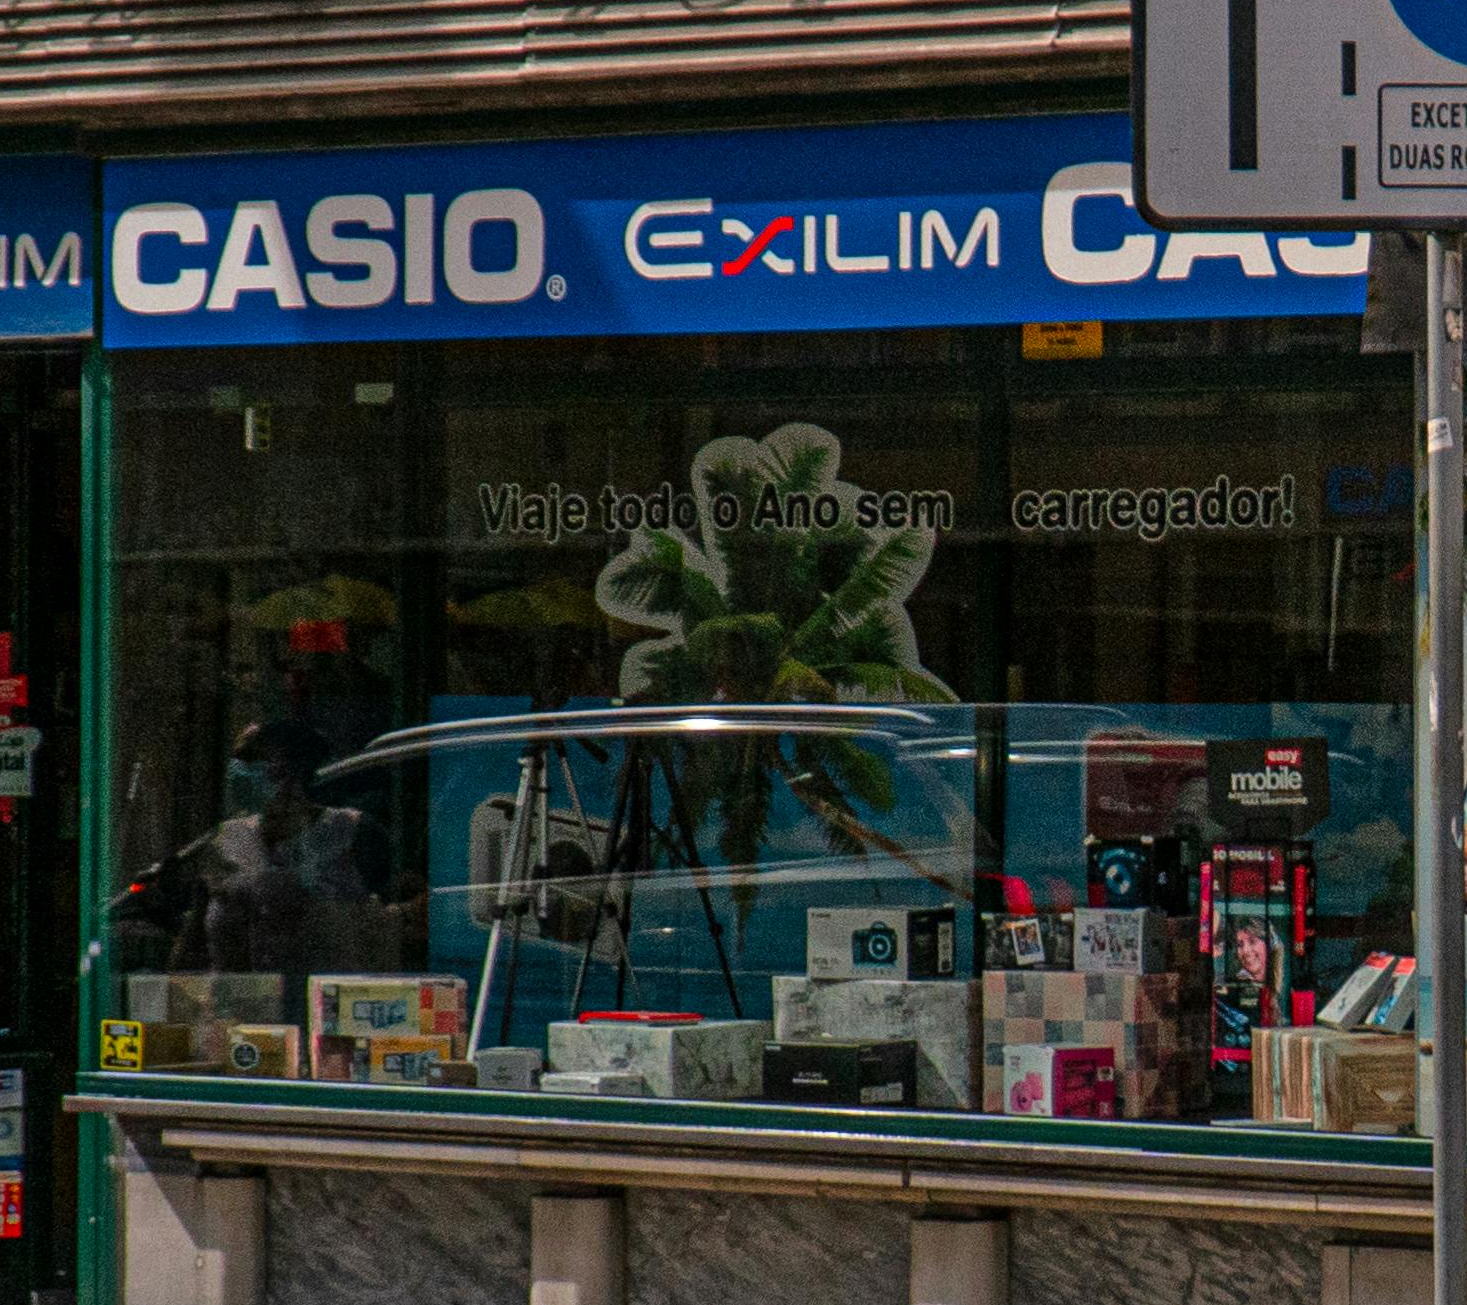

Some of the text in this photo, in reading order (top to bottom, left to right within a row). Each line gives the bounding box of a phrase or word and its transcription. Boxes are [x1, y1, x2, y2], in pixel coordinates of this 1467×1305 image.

[1390, 143, 1445, 170] DUAS
[111, 188, 546, 315] CASIO
[623, 197, 1001, 279] EXILIM
[479, 484, 586, 545] Viaje
[602, 484, 698, 531] todo
[713, 497, 740, 531] o
[753, 484, 840, 531] Ano
[856, 491, 953, 531] sem
[1012, 475, 1295, 541] carregador!
[1230, 765, 1303, 791] mobile
